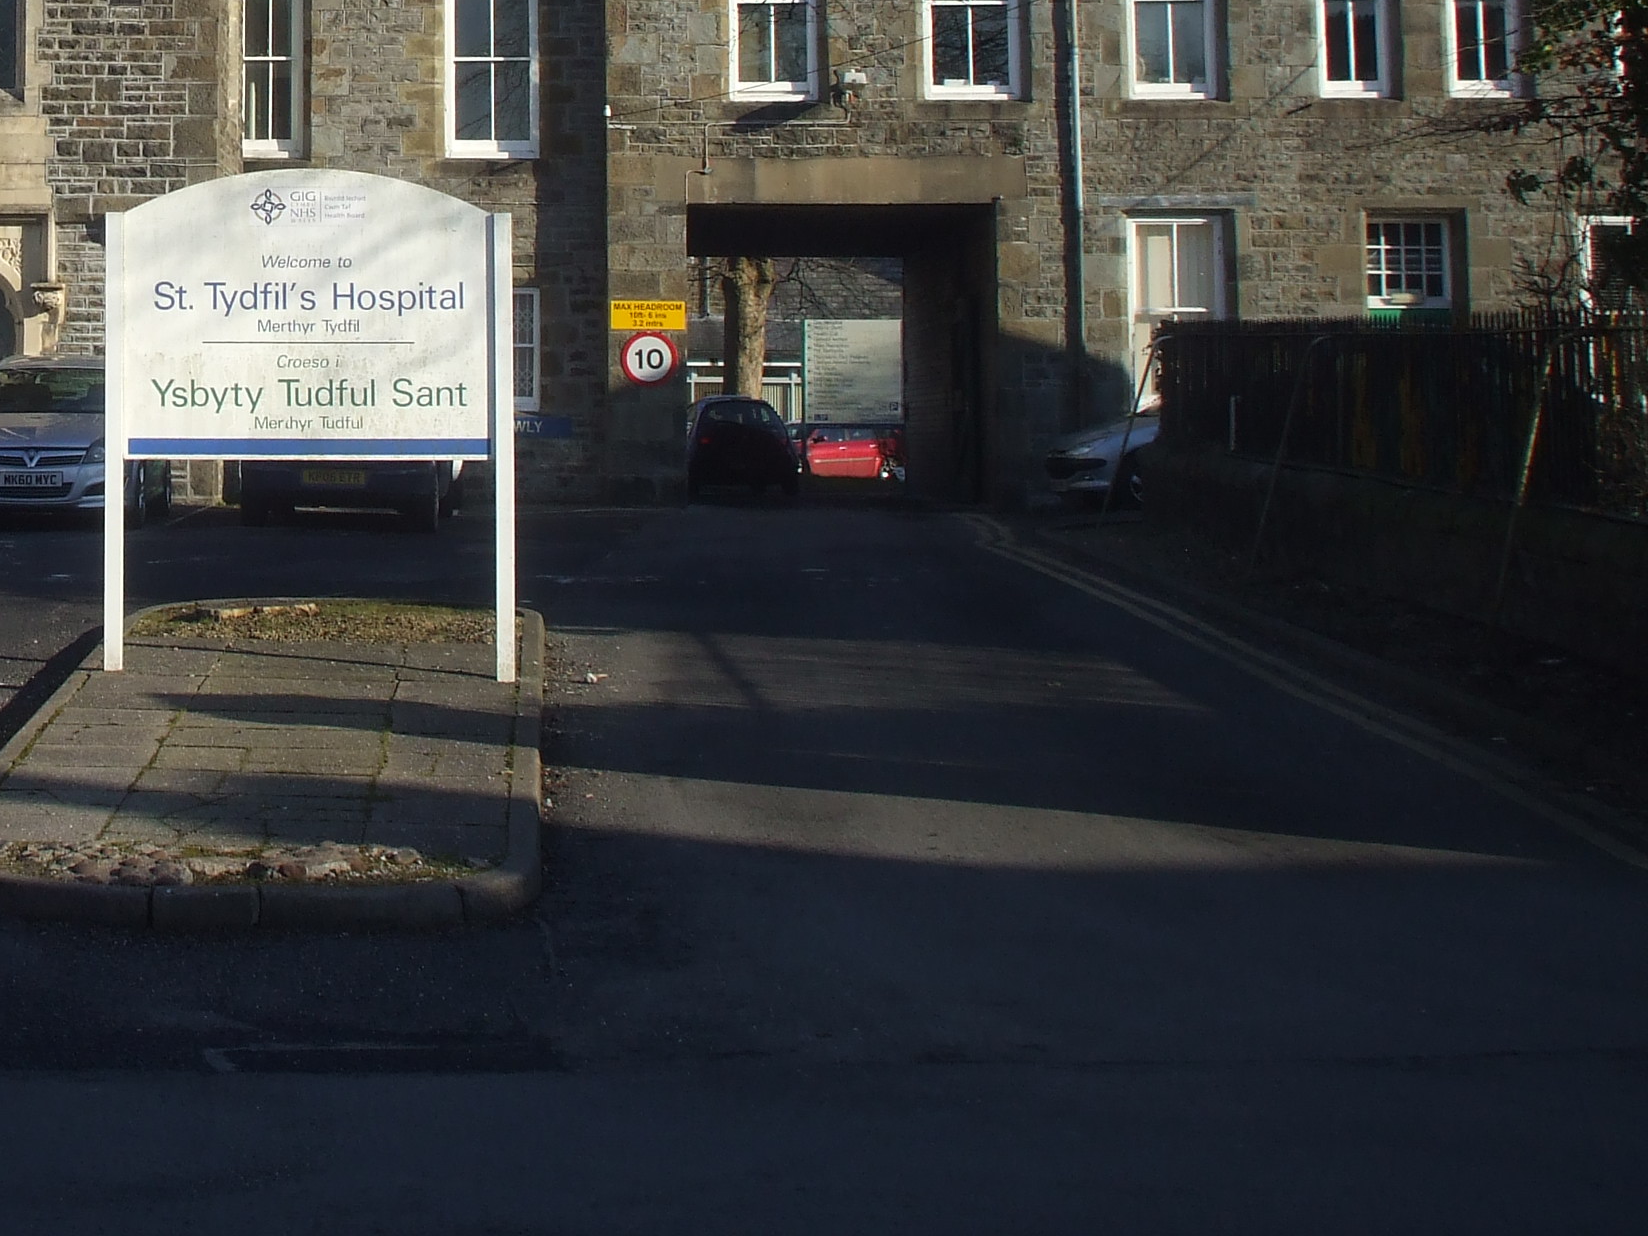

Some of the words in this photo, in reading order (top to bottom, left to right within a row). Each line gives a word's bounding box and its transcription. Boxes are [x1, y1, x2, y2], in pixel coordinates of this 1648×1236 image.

[290, 191, 317, 202] GIG
[290, 208, 317, 218] NHS
[261, 254, 331, 269] Welcome
[338, 256, 353, 269] to
[153, 281, 194, 311] St.
[204, 281, 317, 317] Tydfil's
[333, 281, 465, 316] Hospital
[613, 303, 632, 311] MAX
[634, 303, 682, 311] HEADROOM
[257, 319, 316, 334] Merthyr
[322, 319, 360, 334] Tydfil
[276, 354, 330, 369] Croeso
[335, 354, 340, 369] i
[634, 348, 664, 369] 10
[151, 378, 264, 414] Ysbyty
[278, 378, 377, 408] Tudful
[392, 378, 468, 408] Sant
[254, 416, 313, 433] Merthyr
[319, 416, 364, 430] Tudful
